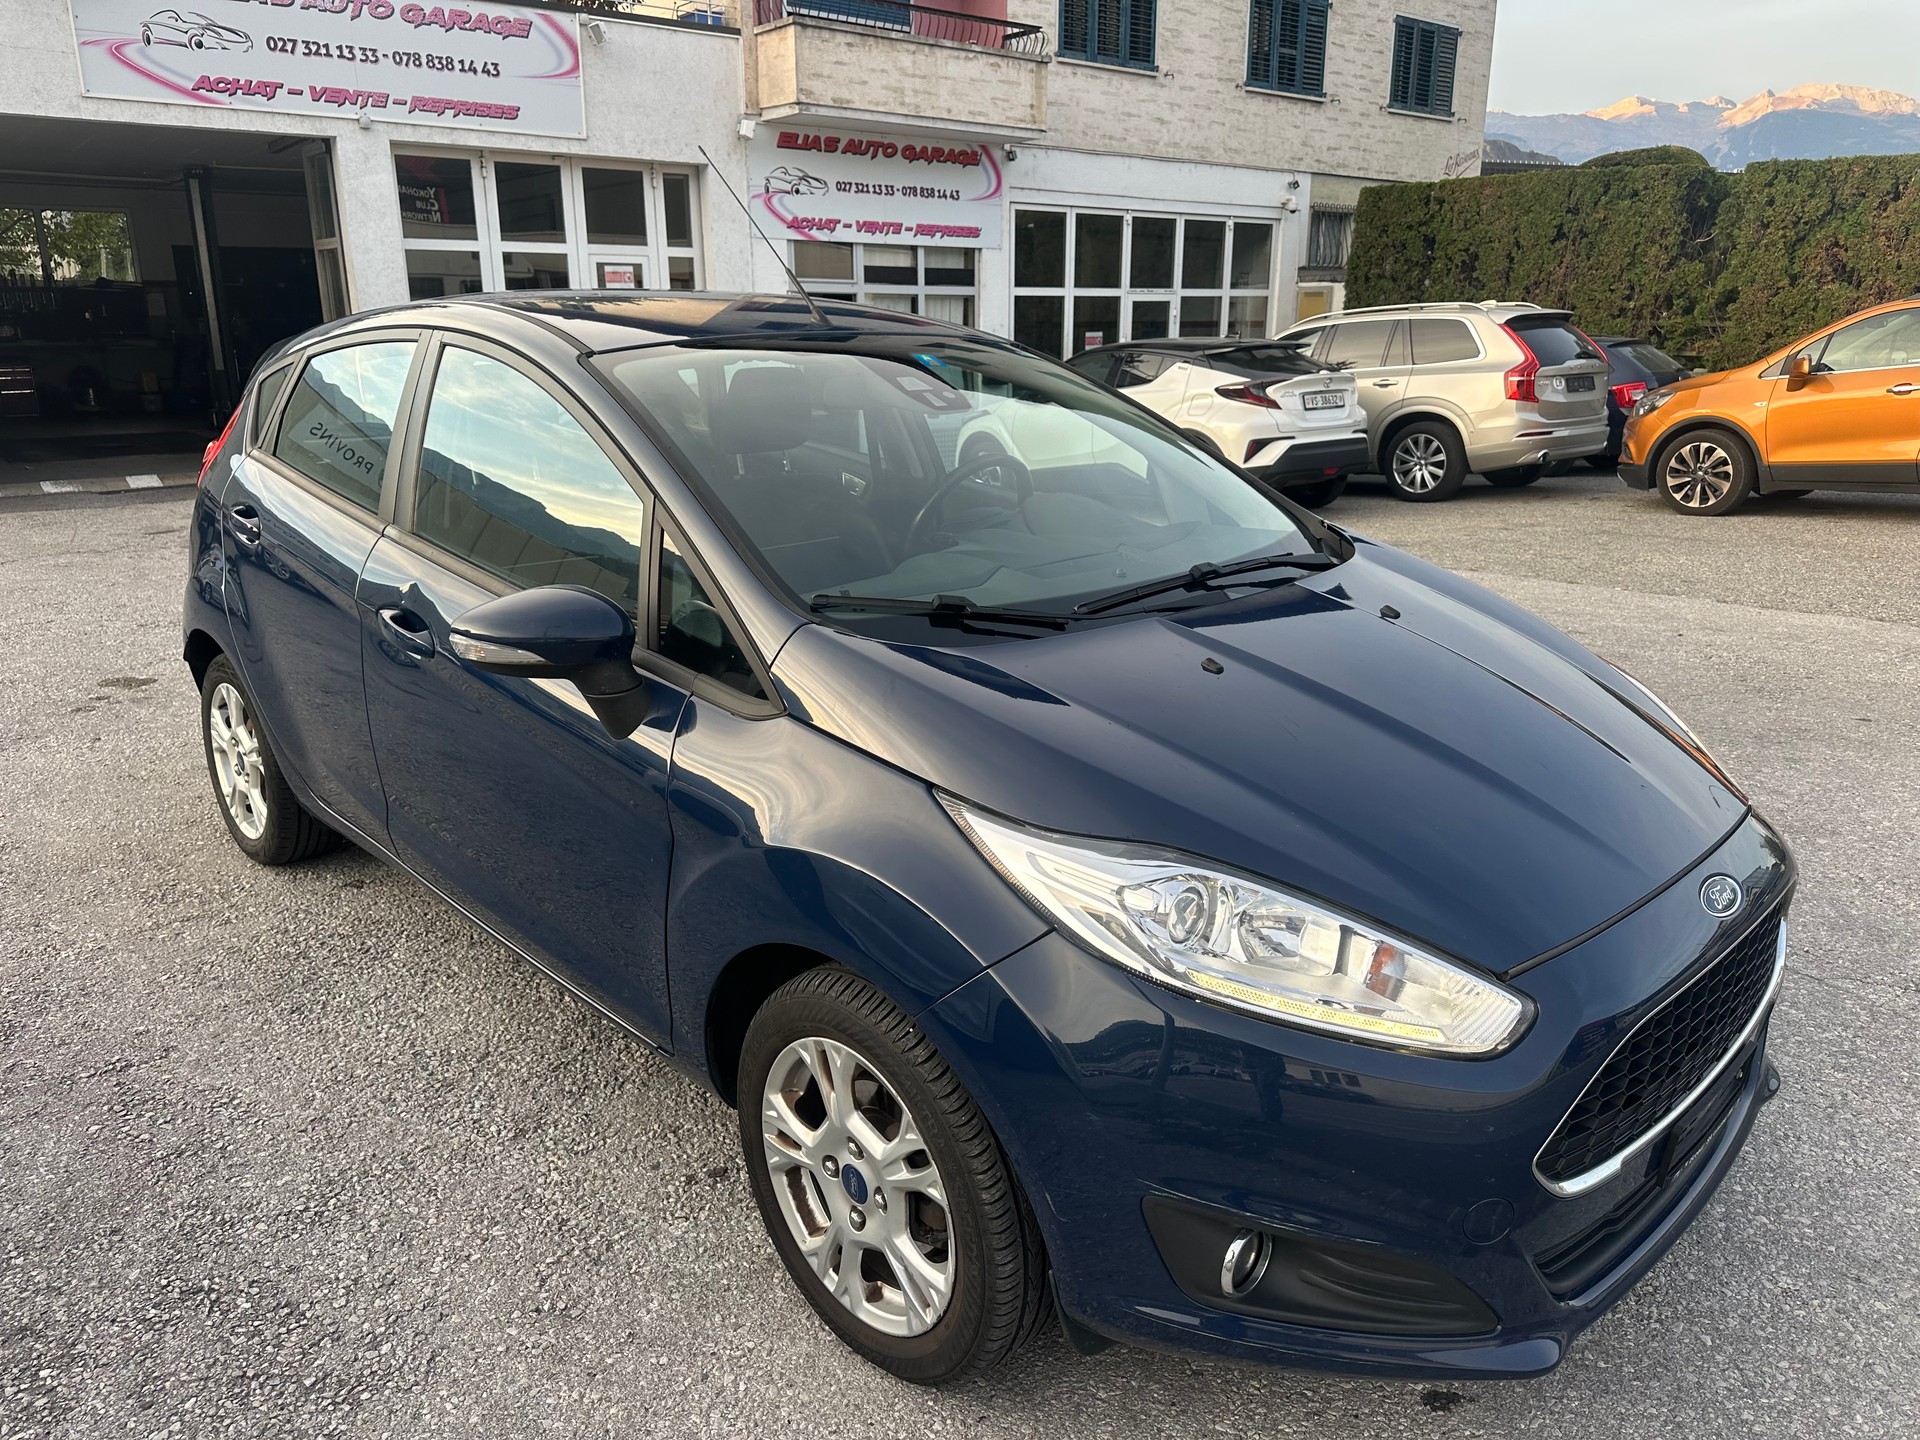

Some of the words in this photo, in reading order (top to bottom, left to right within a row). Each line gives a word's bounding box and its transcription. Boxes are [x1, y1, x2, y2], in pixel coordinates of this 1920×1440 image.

[400, 3, 533, 40] GARAGE
[265, 36, 298, 55] 027
[301, 40, 333, 58] 321
[335, 44, 356, 61] 13
[358, 47, 380, 64] 33
[392, 50, 423, 68] 078
[425, 54, 455, 71] 838
[457, 59, 478, 75] 14
[481, 62, 501, 77] 43
[191, 75, 284, 101] ACHAT
[308, 85, 390, 109] VENTE
[408, 95, 521, 120] REPRISES
[776, 131, 841, 153] ELIAS
[841, 138, 898, 160] AUTO
[901, 144, 983, 168] GARAGE
[835, 180, 853, 194] 027
[854, 182, 871, 195] 321
[872, 184, 884, 196] 13
[884, 184, 895, 197] 33
[901, 186, 918, 198] 078
[919, 187, 936, 200] 838
[937, 189, 948, 201] 14
[949, 190, 960, 201] 43
[786, 216, 841, 233] ACHAT
[855, 220, 902, 236] VENTE
[914, 223, 982, 239] REPRISES
[1708, 884, 1735, 910] Ford
